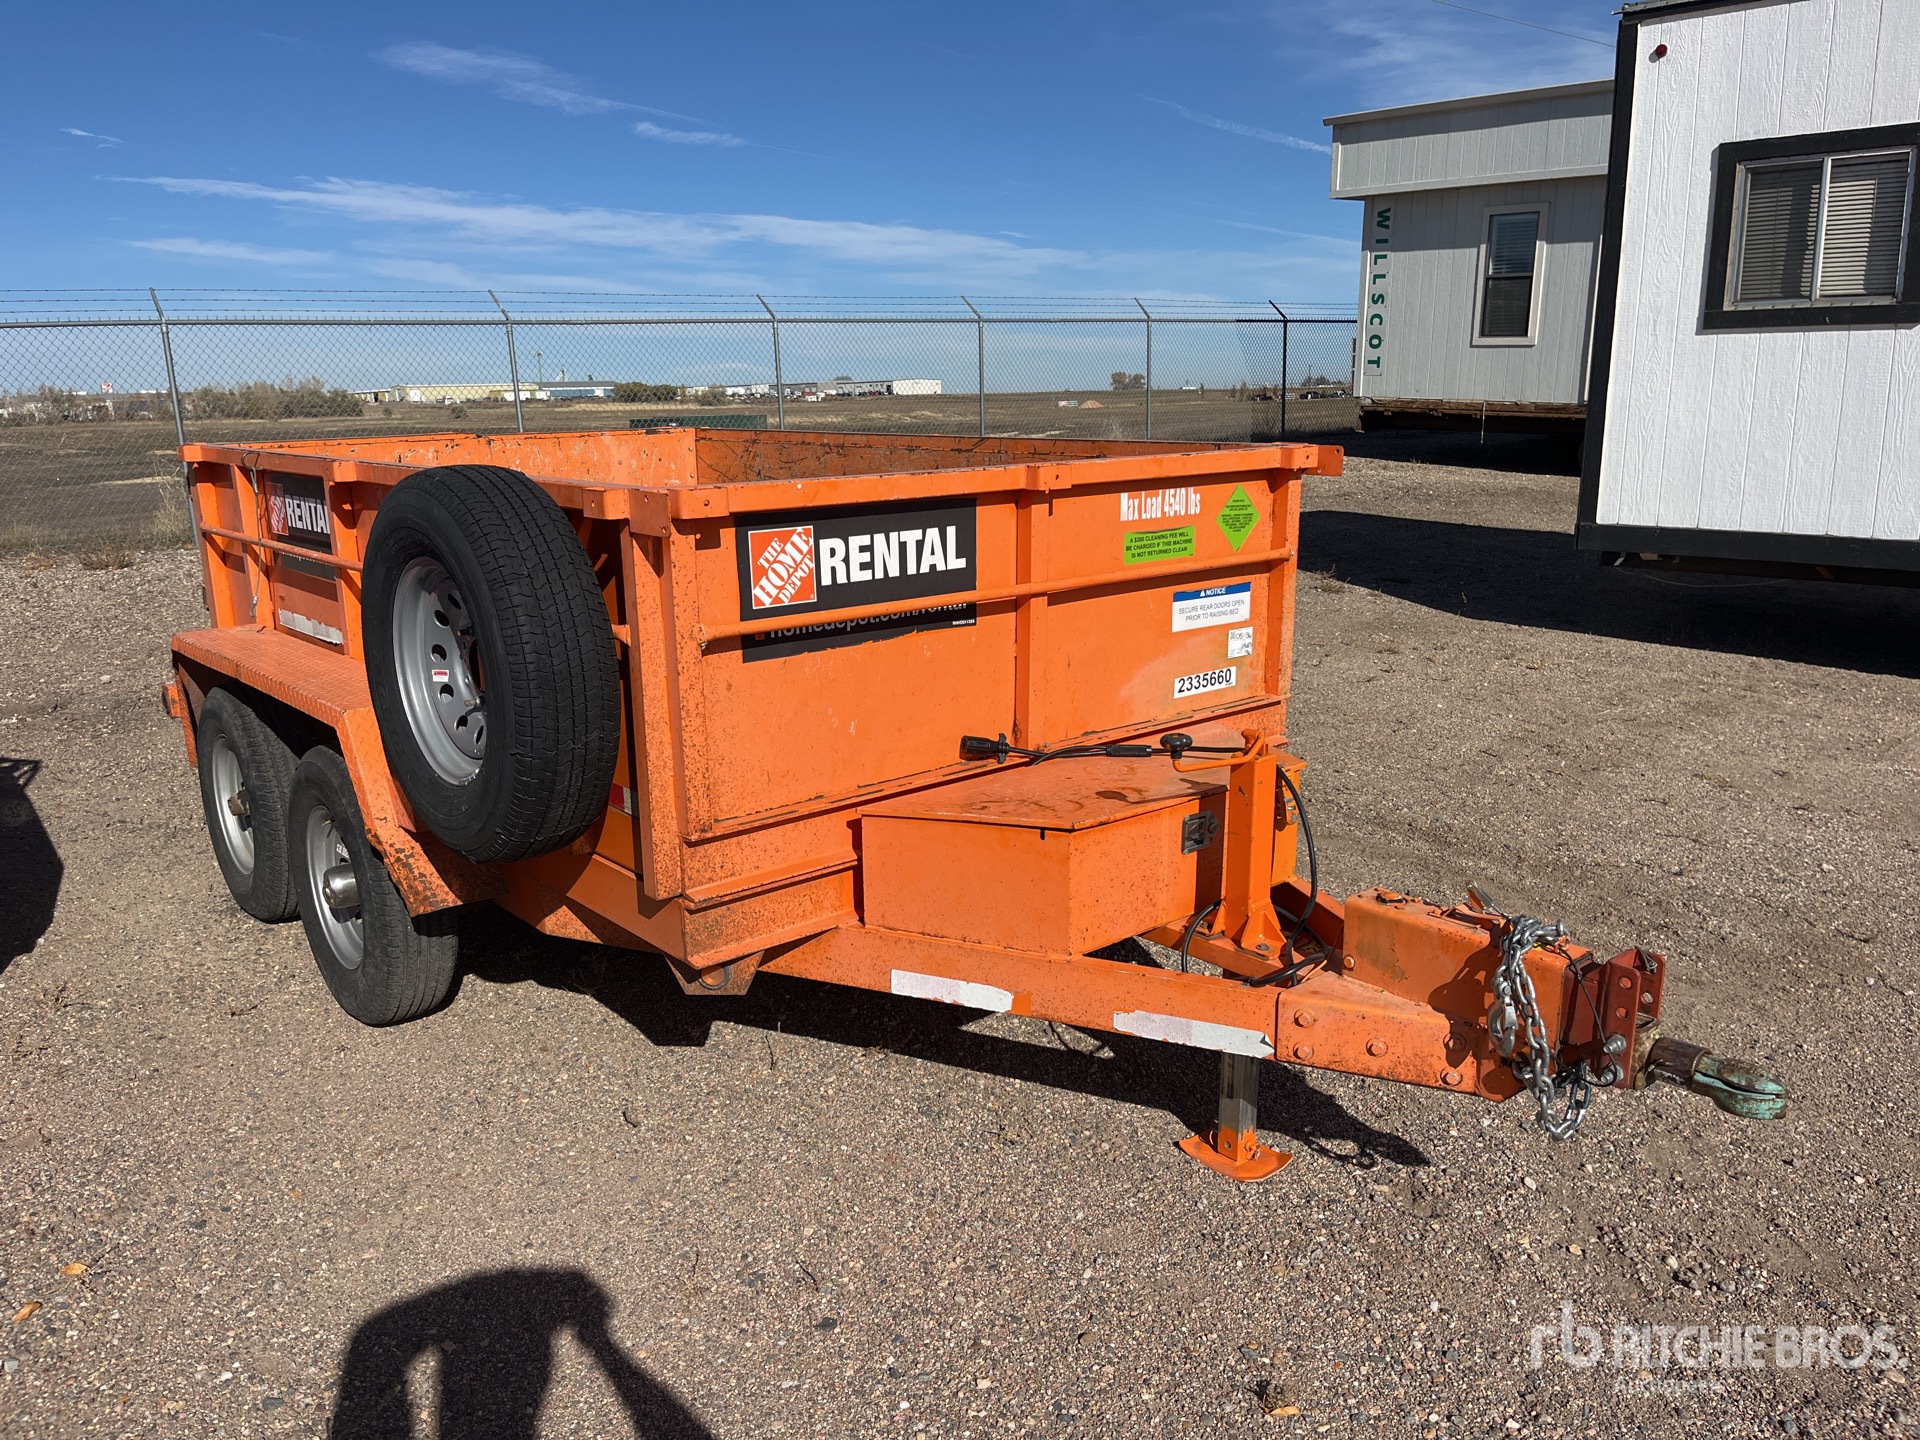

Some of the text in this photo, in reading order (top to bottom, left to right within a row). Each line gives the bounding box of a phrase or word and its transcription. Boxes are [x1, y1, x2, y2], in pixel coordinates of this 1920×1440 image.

[1367, 207, 1391, 368] WILLSCOT
[1120, 486, 1201, 521] Max Load 4540 lbs
[752, 527, 814, 607] HOME
[757, 537, 784, 570] THE
[819, 525, 967, 586] RENTAL
[1147, 548, 1171, 556] RETURNED
[778, 554, 814, 604] DEPOT
[1206, 587, 1226, 596] NOTICE
[1179, 605, 1198, 614] SECURE
[1200, 603, 1213, 611] REAR
[1214, 601, 1231, 609] DOORS
[1210, 609, 1228, 618] RAISING
[1229, 608, 1239, 616] BED
[1178, 668, 1232, 693] 2335660
